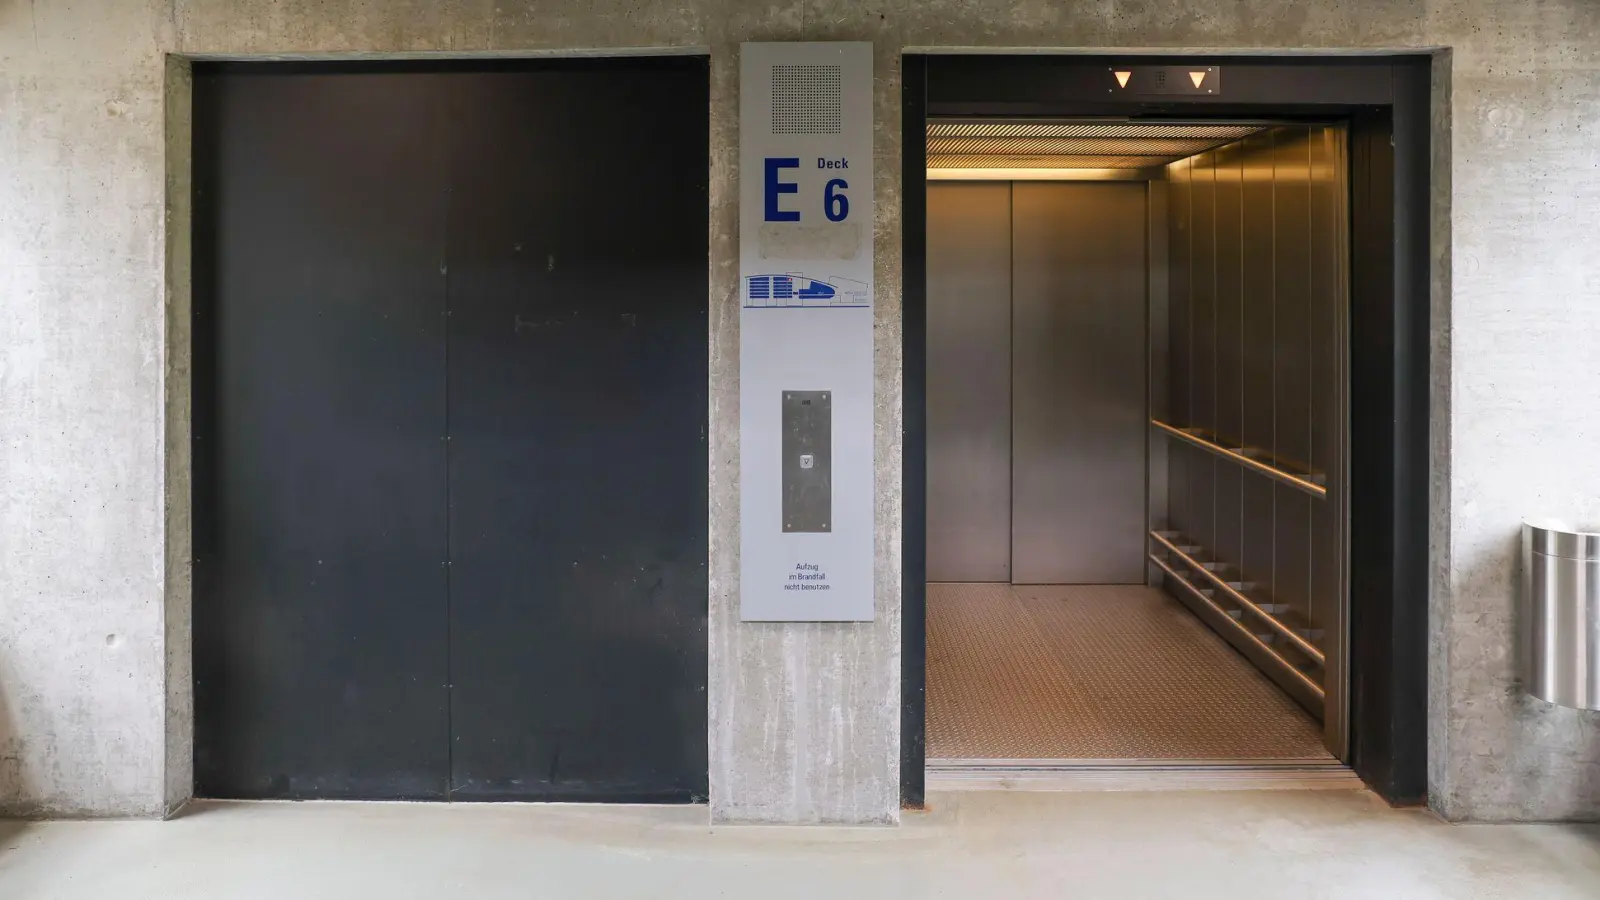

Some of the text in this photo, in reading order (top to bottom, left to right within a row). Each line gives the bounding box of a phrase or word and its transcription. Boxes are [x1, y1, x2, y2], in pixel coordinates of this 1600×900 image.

[817, 157, 848, 169] Deck
[764, 157, 800, 221] E
[824, 178, 849, 222] 6
[796, 563, 819, 571] Aufzug
